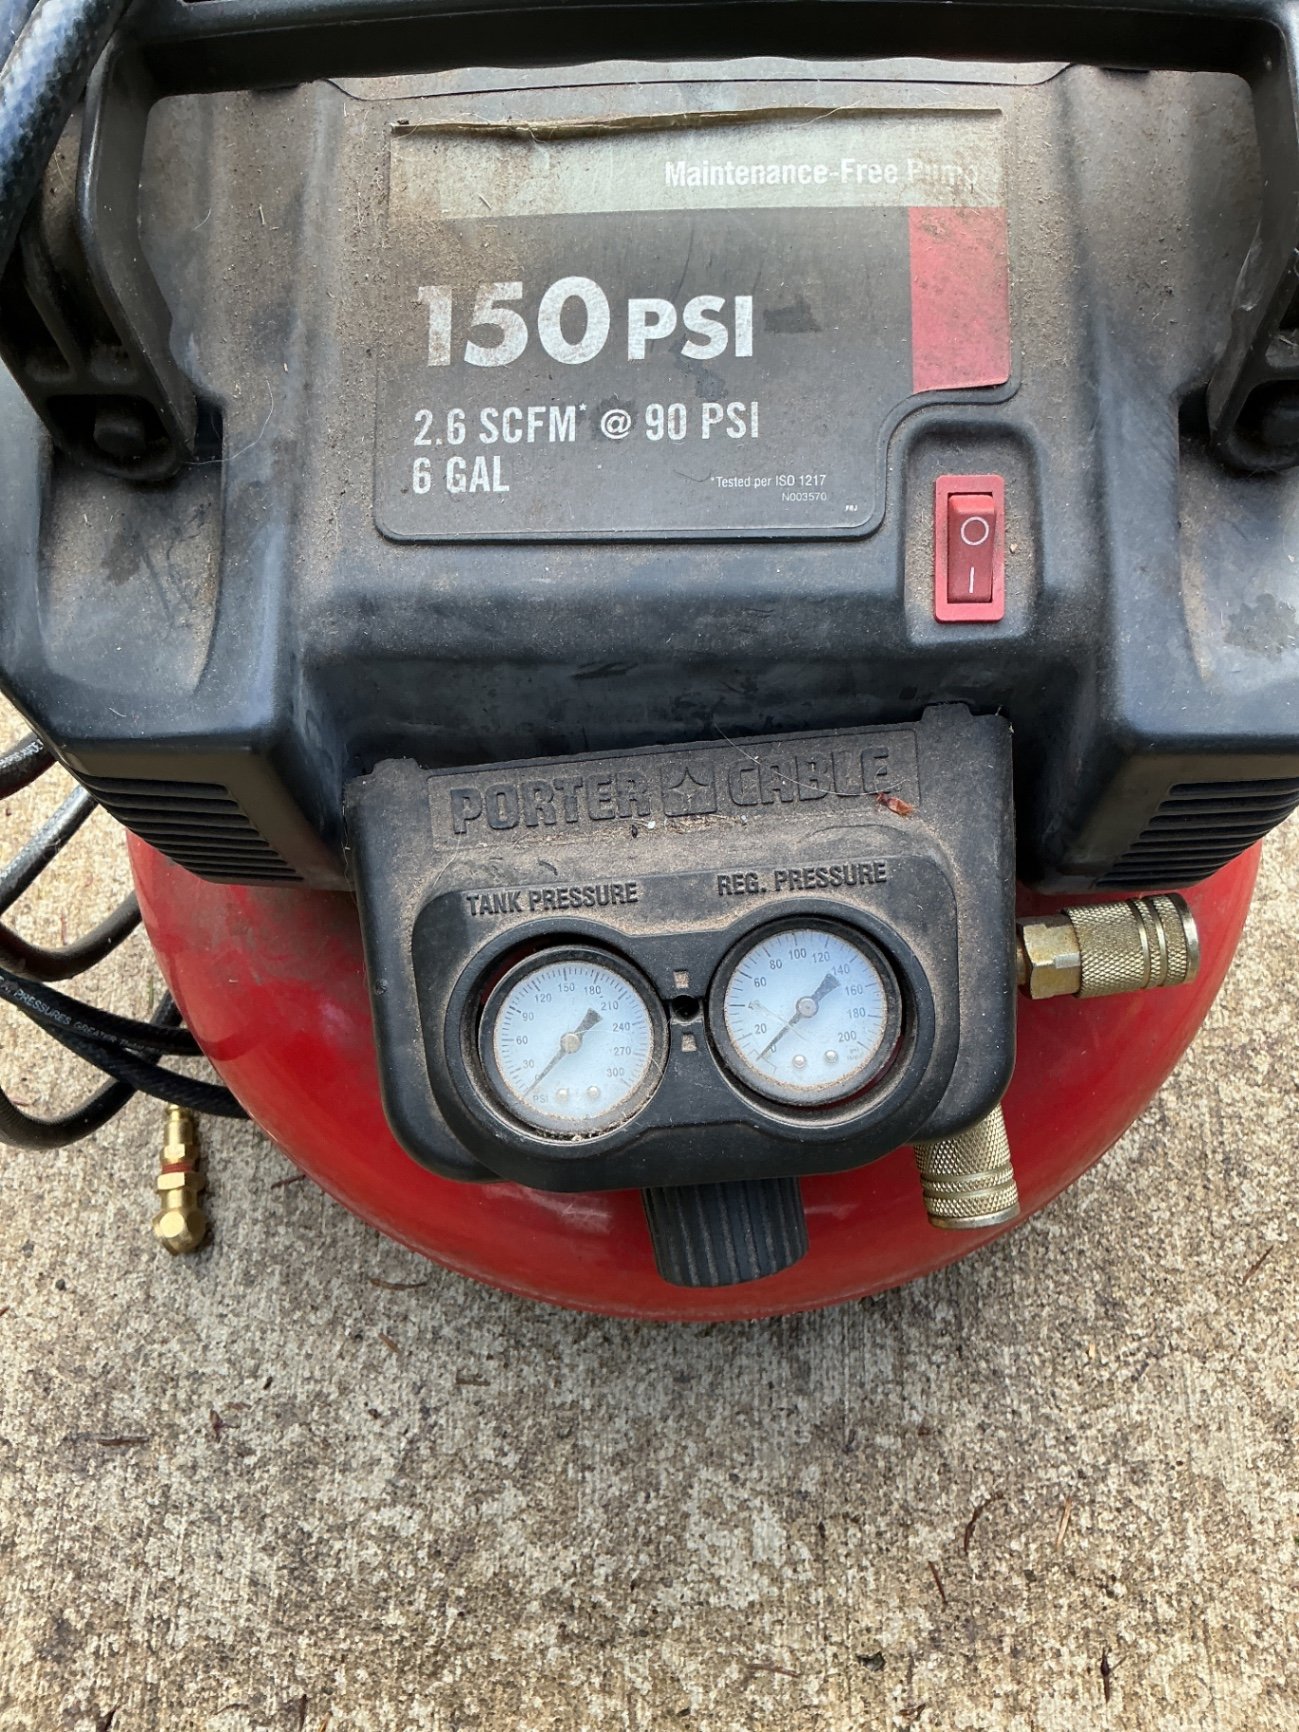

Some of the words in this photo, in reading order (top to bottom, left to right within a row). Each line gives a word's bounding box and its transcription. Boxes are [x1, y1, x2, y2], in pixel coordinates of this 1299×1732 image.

[665, 158, 898, 187] Maintenance-Free
[418, 276, 610, 368] 150
[628, 295, 753, 361] PSI
[414, 409, 466, 446] 2.6
[600, 409, 632, 440] @
[645, 403, 687, 441] 90
[702, 401, 759, 440] PSI
[412, 457, 431, 494] 6
[446, 455, 510, 493] GAL
[754, 477, 771, 489] per
[775, 475, 795, 487] ISO
[799, 475, 826, 486] 1217
[782, 492, 827, 501] N003570
[449, 770, 652, 834] PORTER
[728, 746, 891, 807] CABLE
[717, 872, 768, 896] REG.
[774, 861, 888, 892] PRESSURE
[466, 889, 524, 916] TANK
[528, 881, 639, 912] PRESSURE
[789, 947, 807, 960] 100
[812, 951, 831, 964] 120
[769, 958, 783, 970] 80
[831, 963, 850, 976] 140
[558, 983, 575, 992] 150
[754, 976, 767, 988] 60
[584, 985, 602, 995] 180
[845, 985, 863, 996] 160
[535, 993, 551, 1003] 120
[14, 987, 71, 1025] PRESSURES
[601, 1001, 619, 1011] 210
[522, 1012, 534, 1021] 90
[848, 1007, 866, 1019] 180
[613, 1022, 631, 1032] 240
[755, 1023, 767, 1034] 20
[516, 1036, 528, 1045] 60
[838, 1030, 857, 1043] 200
[614, 1046, 631, 1056] 270
[523, 1059, 534, 1069] 30
[606, 1067, 625, 1077] 300
[532, 1094, 549, 1104] PSI
